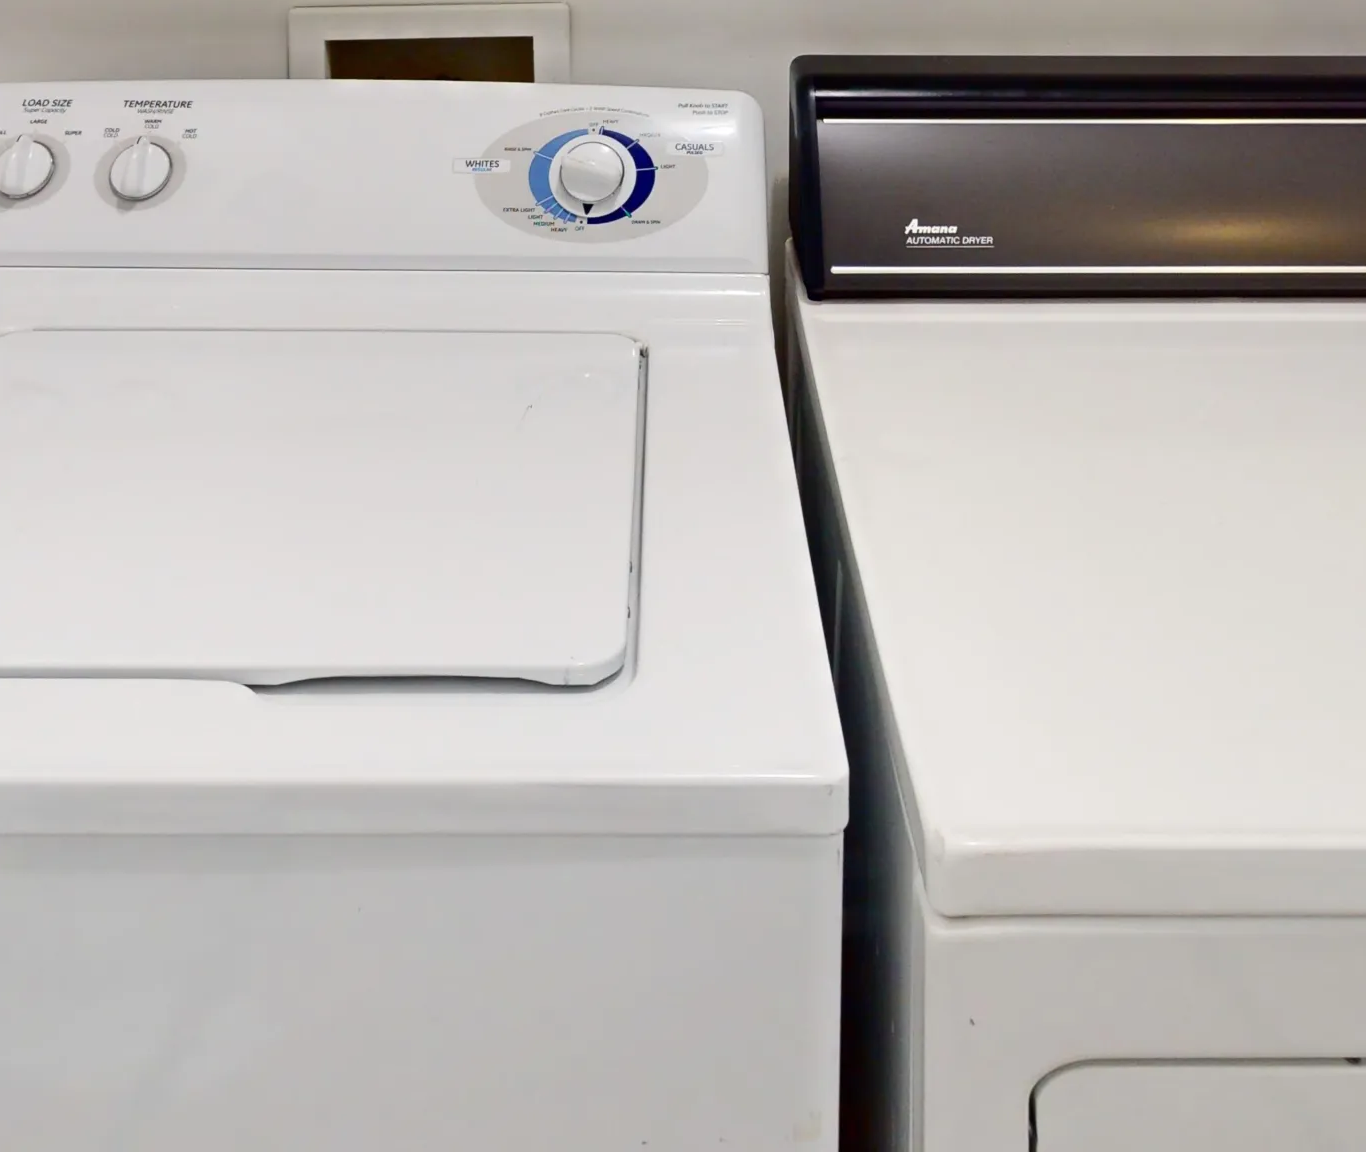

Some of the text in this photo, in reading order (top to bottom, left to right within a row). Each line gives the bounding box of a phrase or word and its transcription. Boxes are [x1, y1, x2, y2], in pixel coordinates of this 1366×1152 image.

[21, 98, 73, 107] LOAD SIZE
[123, 100, 194, 109] TEMPERATURE
[41, 107, 67, 115] Capacity
[674, 143, 715, 151] CASUALS
[465, 159, 500, 168] WHITES
[904, 218, 958, 235] Amana
[906, 236, 994, 245] AUTOMATIC DRYER
